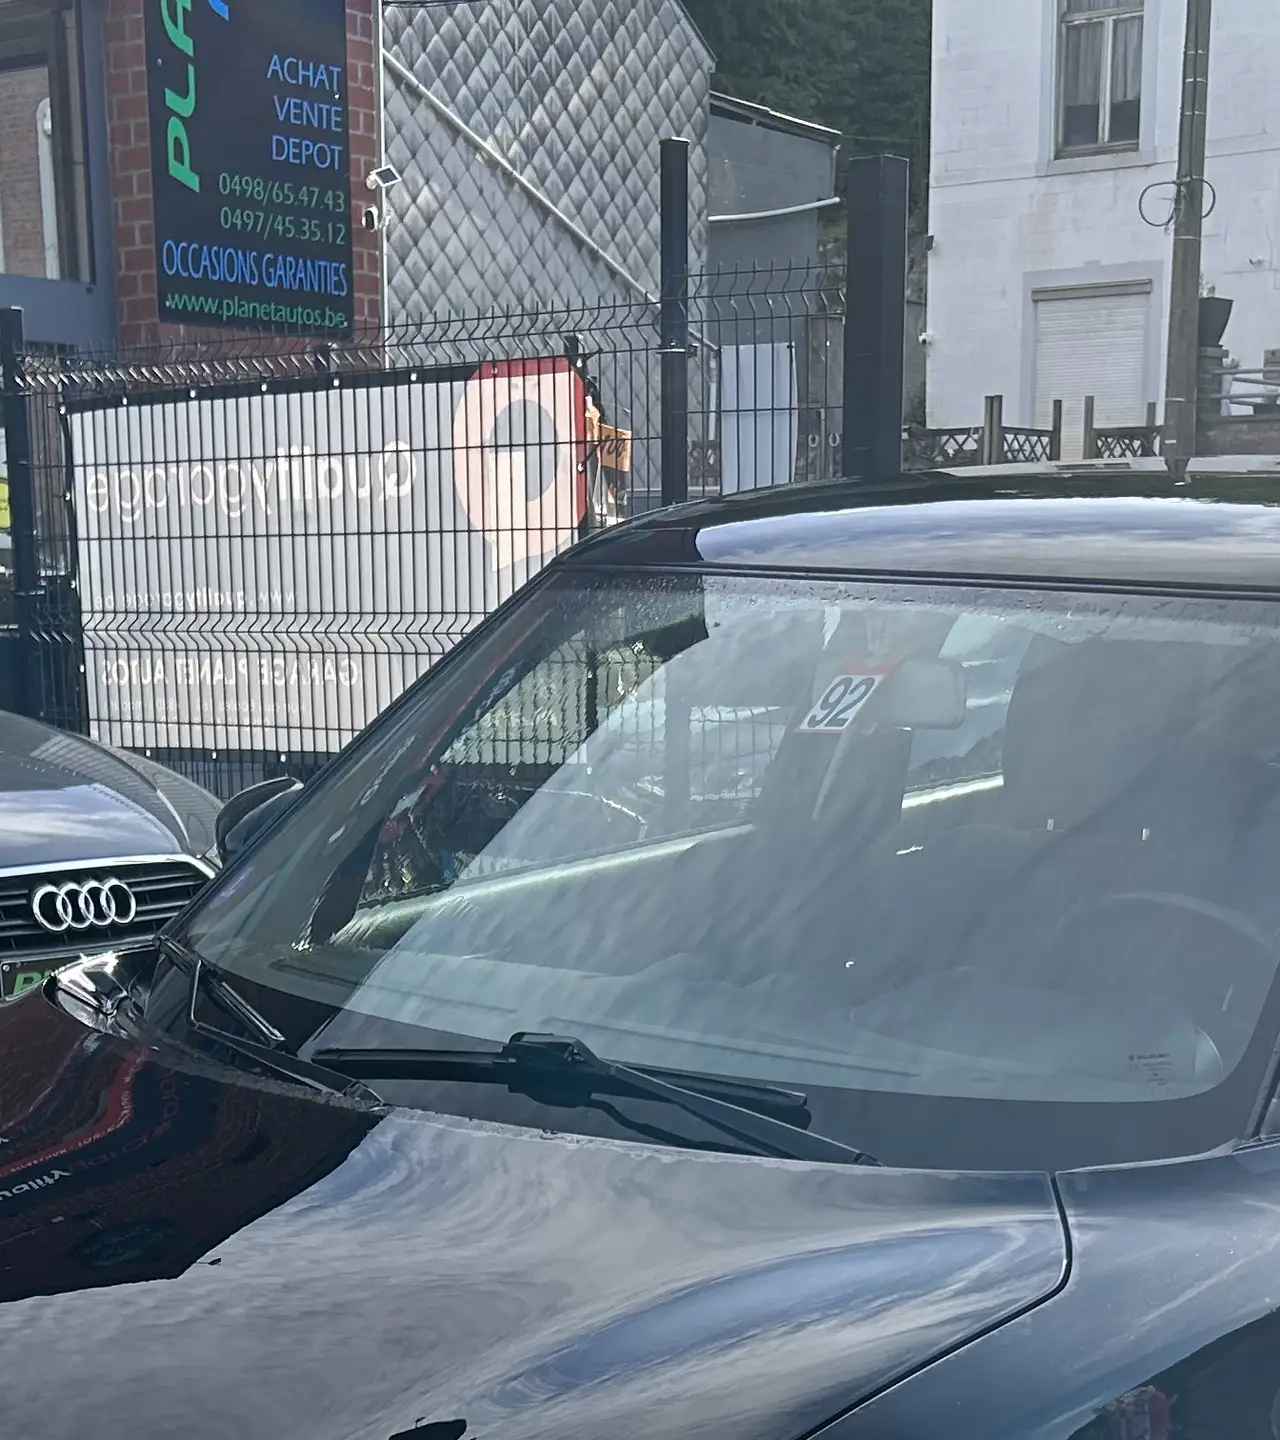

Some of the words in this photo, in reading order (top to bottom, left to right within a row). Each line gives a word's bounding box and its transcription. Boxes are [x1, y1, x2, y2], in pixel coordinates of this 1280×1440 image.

[266, 54, 342, 92] ACHAT
[273, 95, 343, 132] VENTE
[272, 135, 343, 170] DEPOT
[218, 172, 345, 212] 0498/65.47.43
[219, 206, 346, 245] 0497/45.35.12
[162, 239, 259, 286] OCCASIONS
[261, 253, 348, 297] GARANTIES
[807, 676, 876, 729] 92
